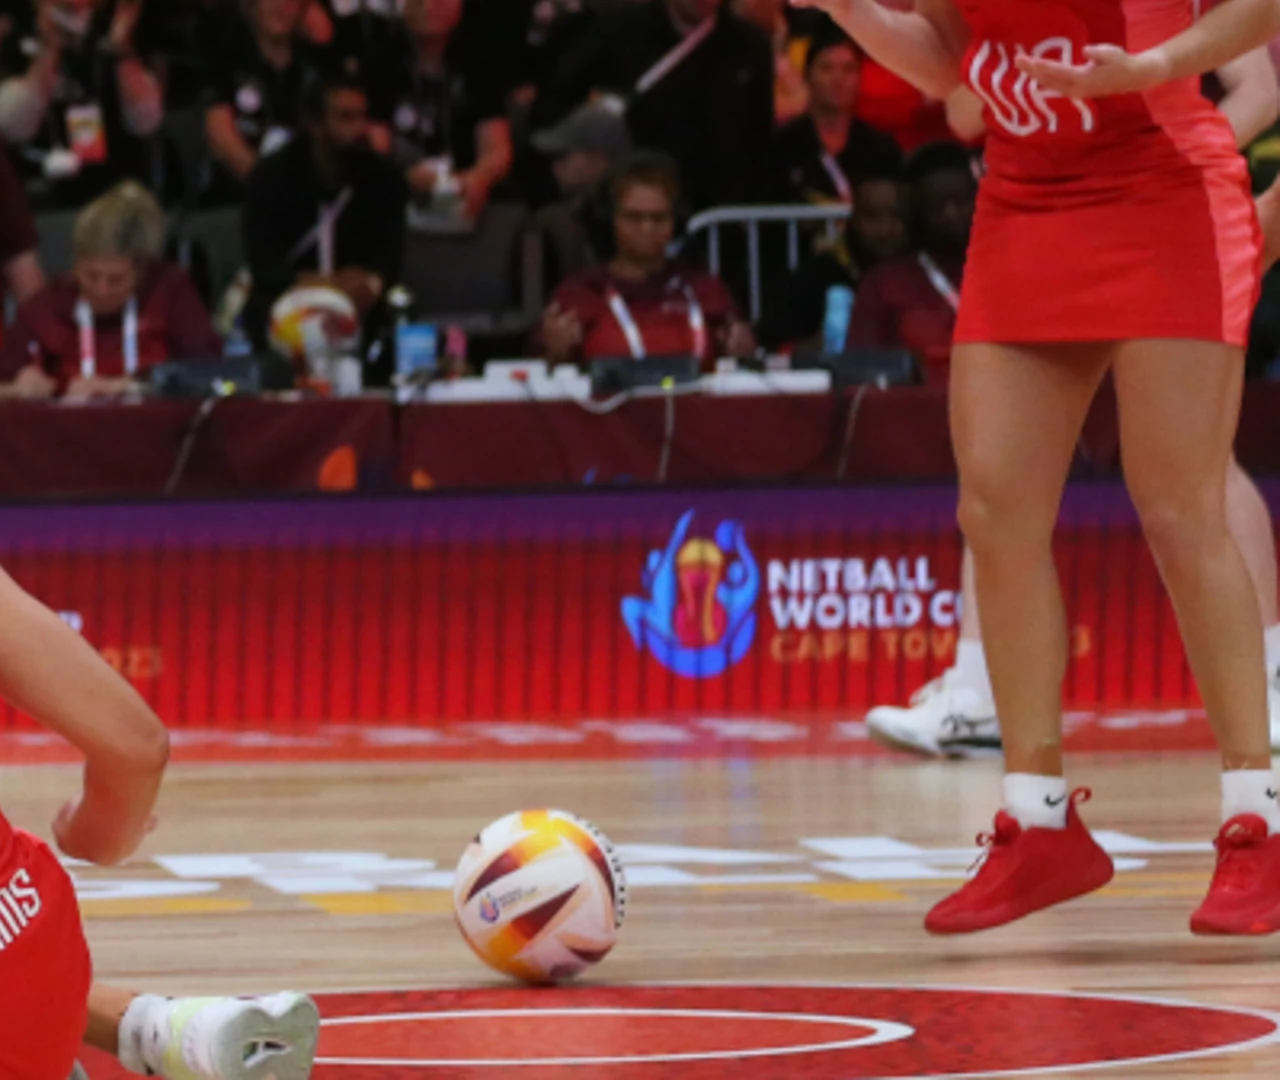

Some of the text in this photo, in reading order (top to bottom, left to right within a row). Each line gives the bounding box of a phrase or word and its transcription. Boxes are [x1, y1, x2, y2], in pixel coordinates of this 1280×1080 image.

[767, 557, 934, 592] NETBALL
[770, 592, 922, 629] WORLD
[771, 628, 871, 662] CAPE
